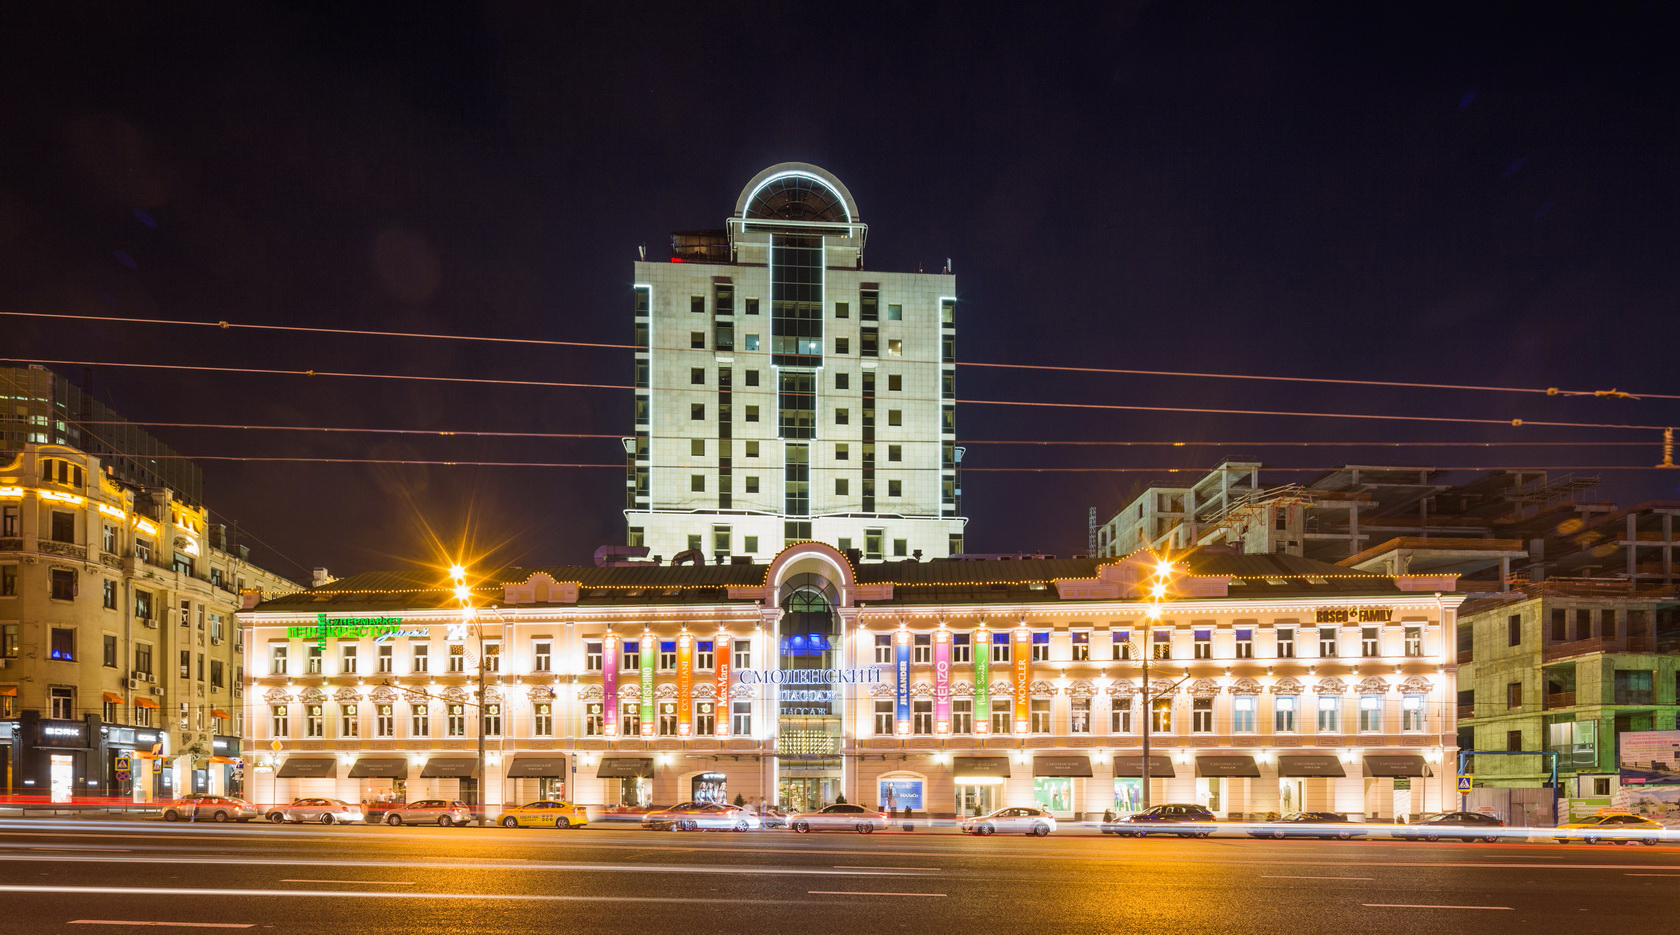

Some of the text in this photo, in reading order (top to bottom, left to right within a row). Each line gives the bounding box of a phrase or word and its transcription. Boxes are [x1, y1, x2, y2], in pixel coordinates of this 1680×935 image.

[1316, 610, 1393, 622] BOSCO FAMILY
[643, 667, 653, 706] MOSCHINO
[718, 664, 728, 707] MaxMara
[739, 666, 881, 684] СМОЛЕНСКИЙ
[937, 661, 948, 704] KENZO
[1018, 659, 1026, 705] MONCLER
